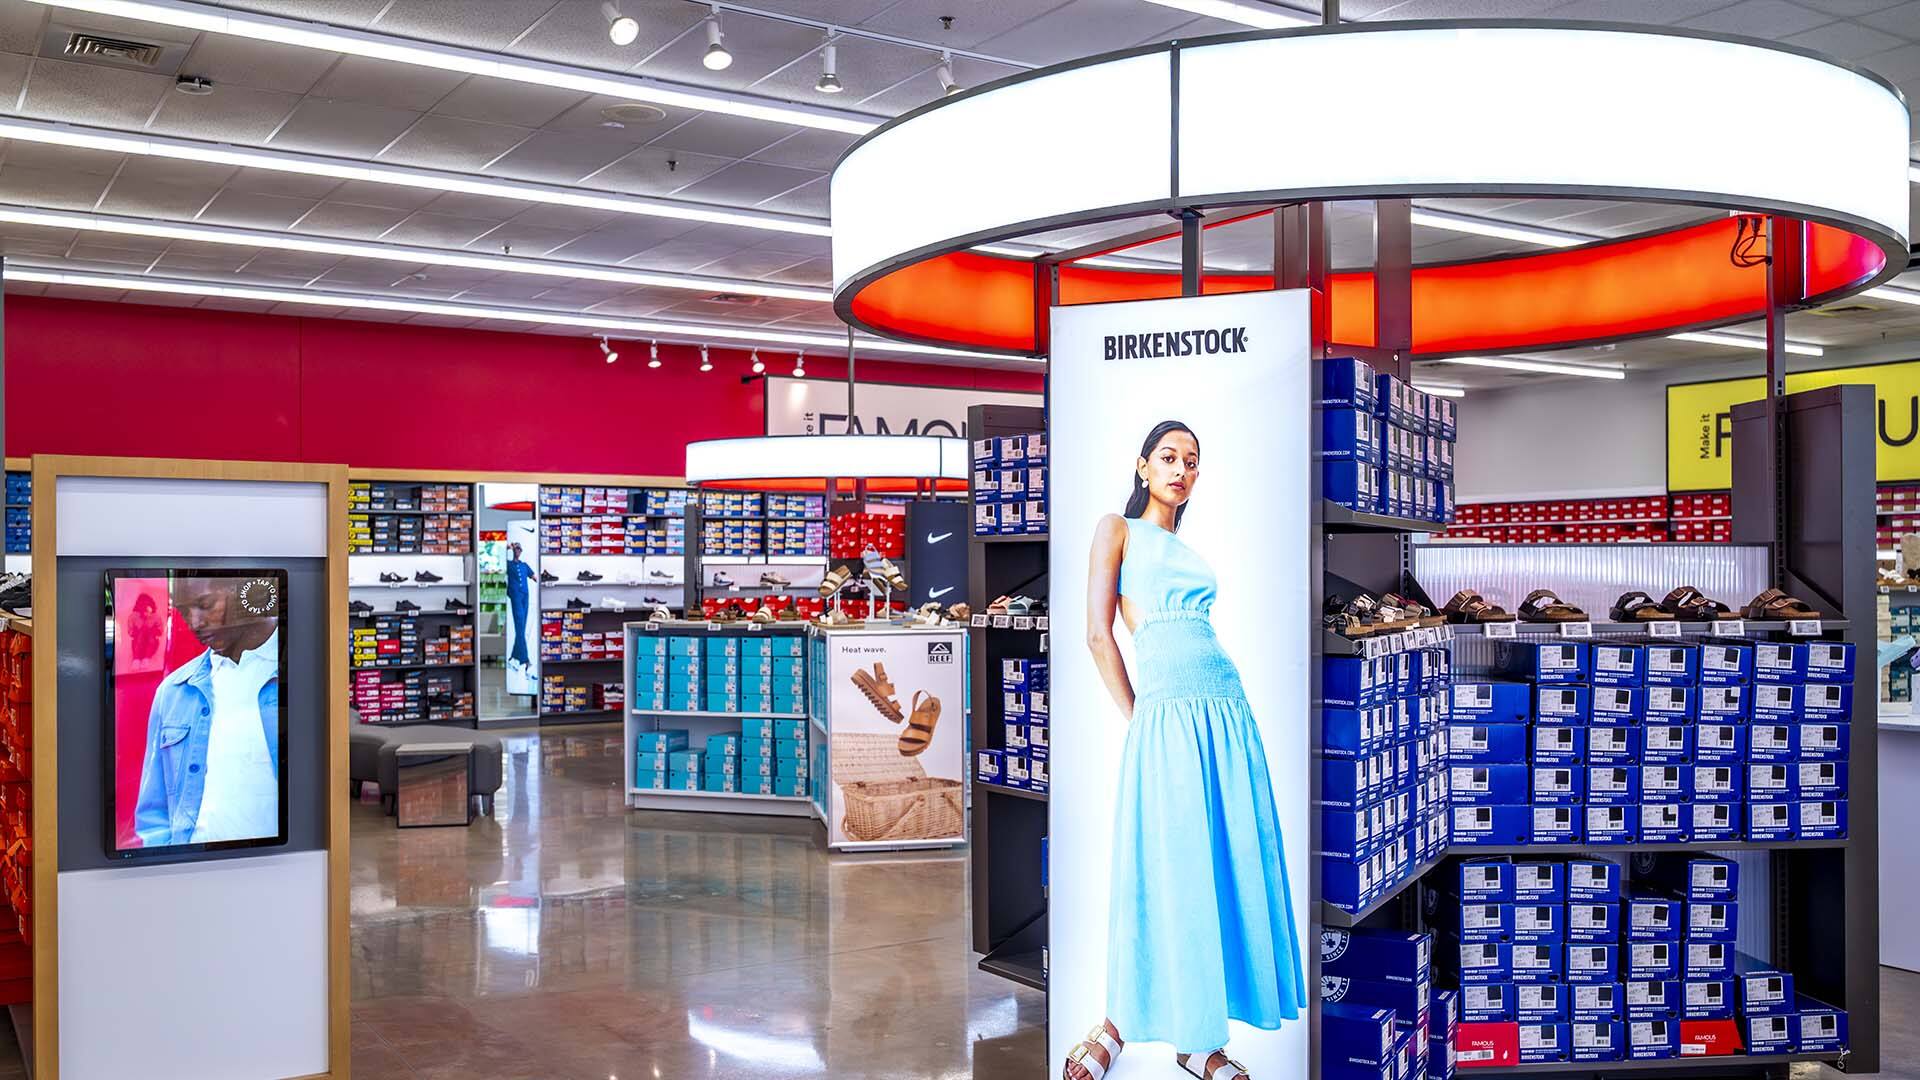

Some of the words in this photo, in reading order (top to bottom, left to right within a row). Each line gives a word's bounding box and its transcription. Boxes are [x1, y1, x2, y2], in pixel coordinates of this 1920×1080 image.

[1699, 412, 1710, 423] it
[1699, 425, 1710, 460] Make
[256, 578, 270, 586] TAP
[240, 581, 252, 599] SHOP
[267, 584, 276, 594] TO
[241, 599, 250, 609] TO
[265, 594, 277, 611] SHOP
[248, 606, 261, 614] TAP
[841, 645, 861, 653] Heat
[929, 654, 951, 663] REEF
